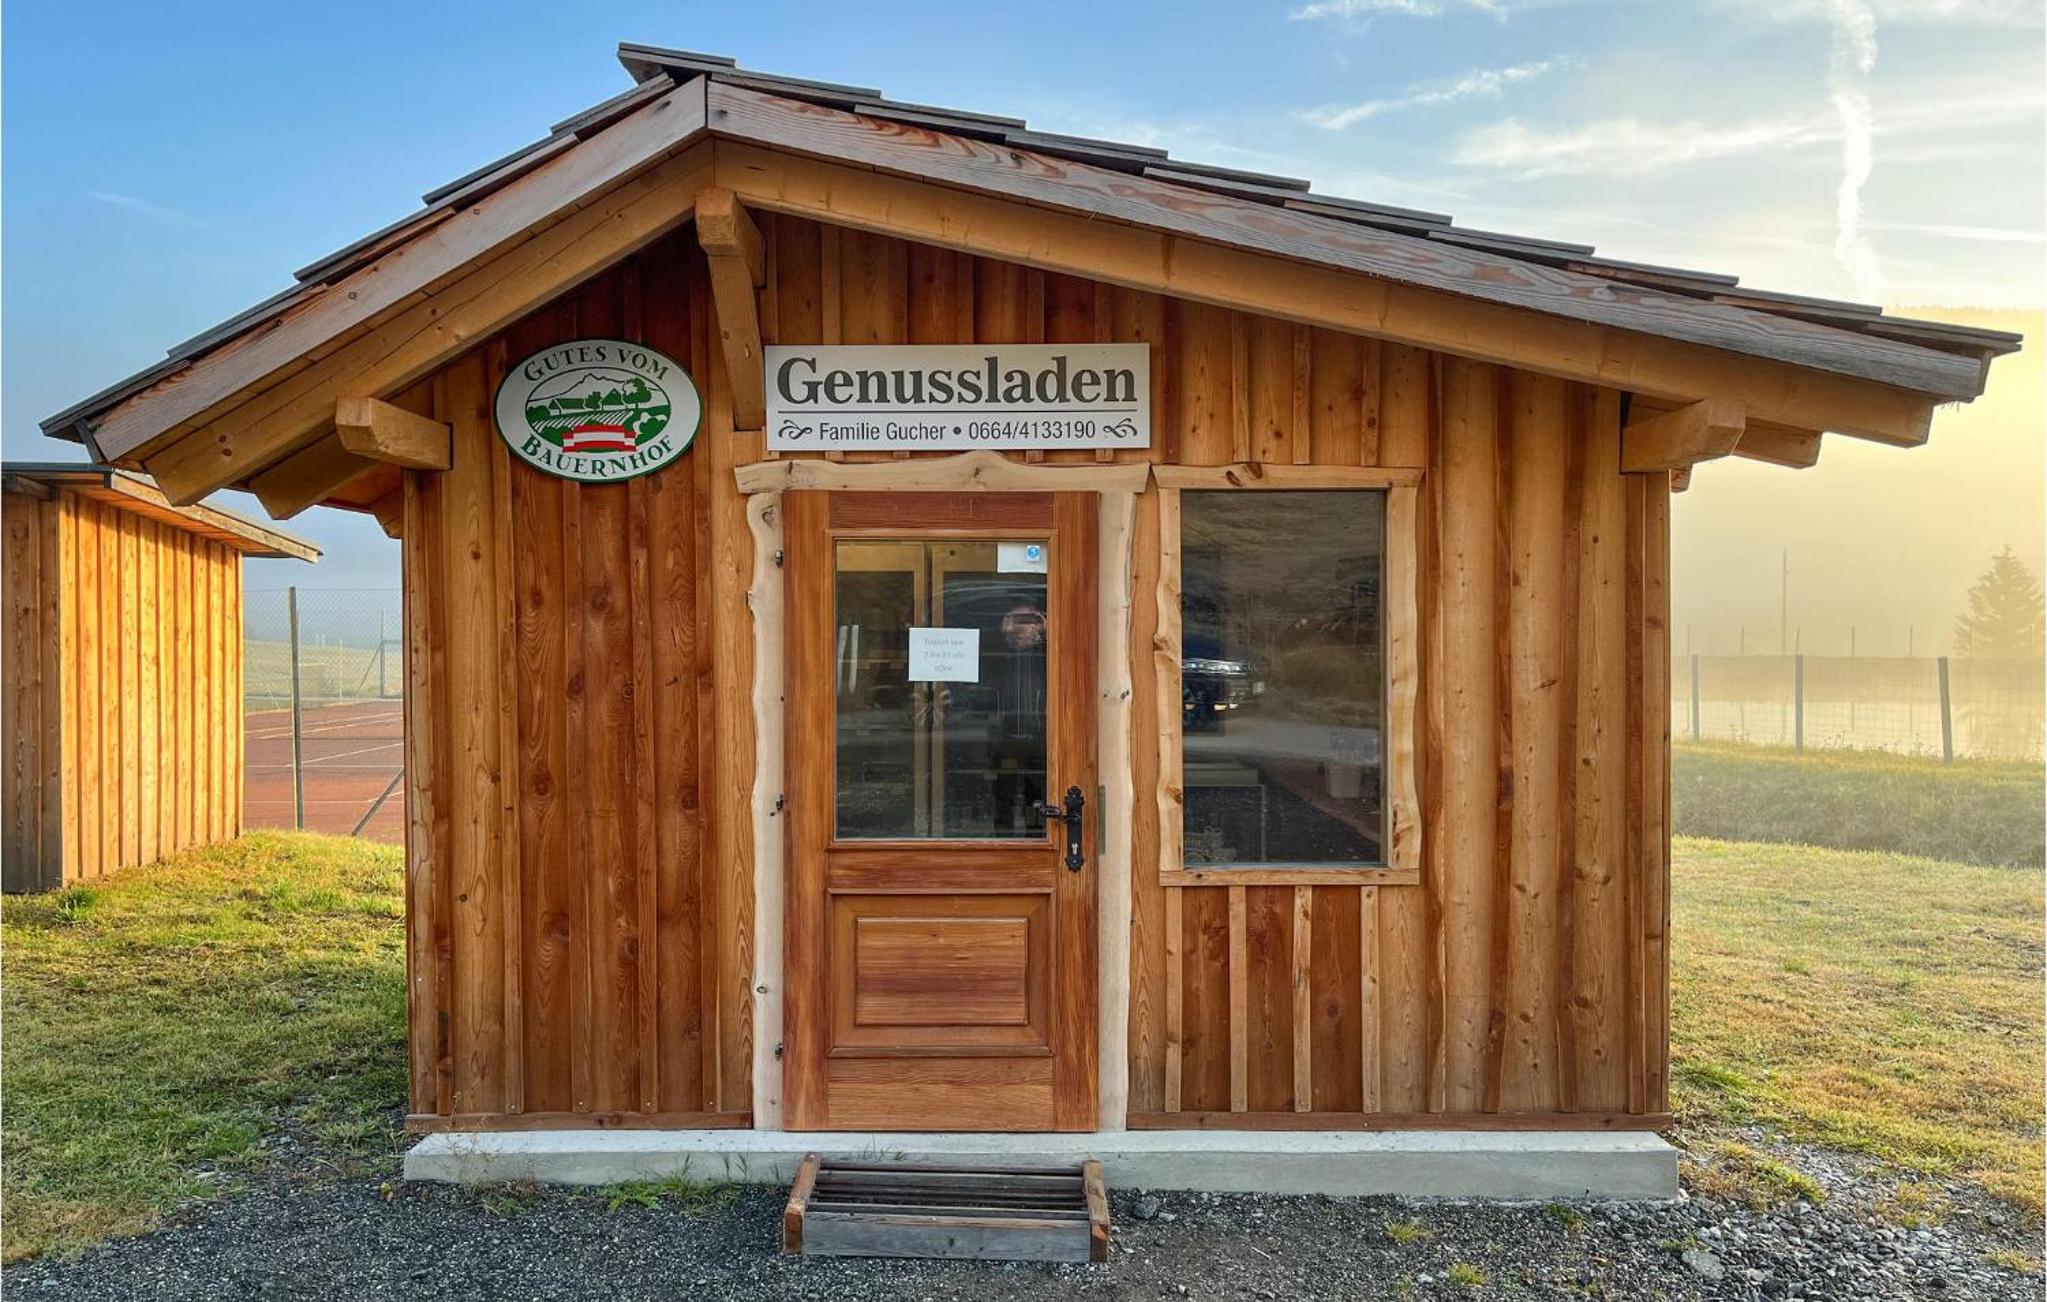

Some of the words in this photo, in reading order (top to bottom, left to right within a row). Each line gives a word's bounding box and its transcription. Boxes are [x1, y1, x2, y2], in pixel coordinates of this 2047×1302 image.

[523, 345, 607, 382] GUTES
[617, 347, 669, 381] VOM
[777, 355, 1138, 405] Genussladen
[819, 421, 880, 441] Familie
[886, 421, 947, 441] Gucher
[968, 420, 1096, 441] 0664/4133190
[520, 433, 675, 477] BAUERNHOF
